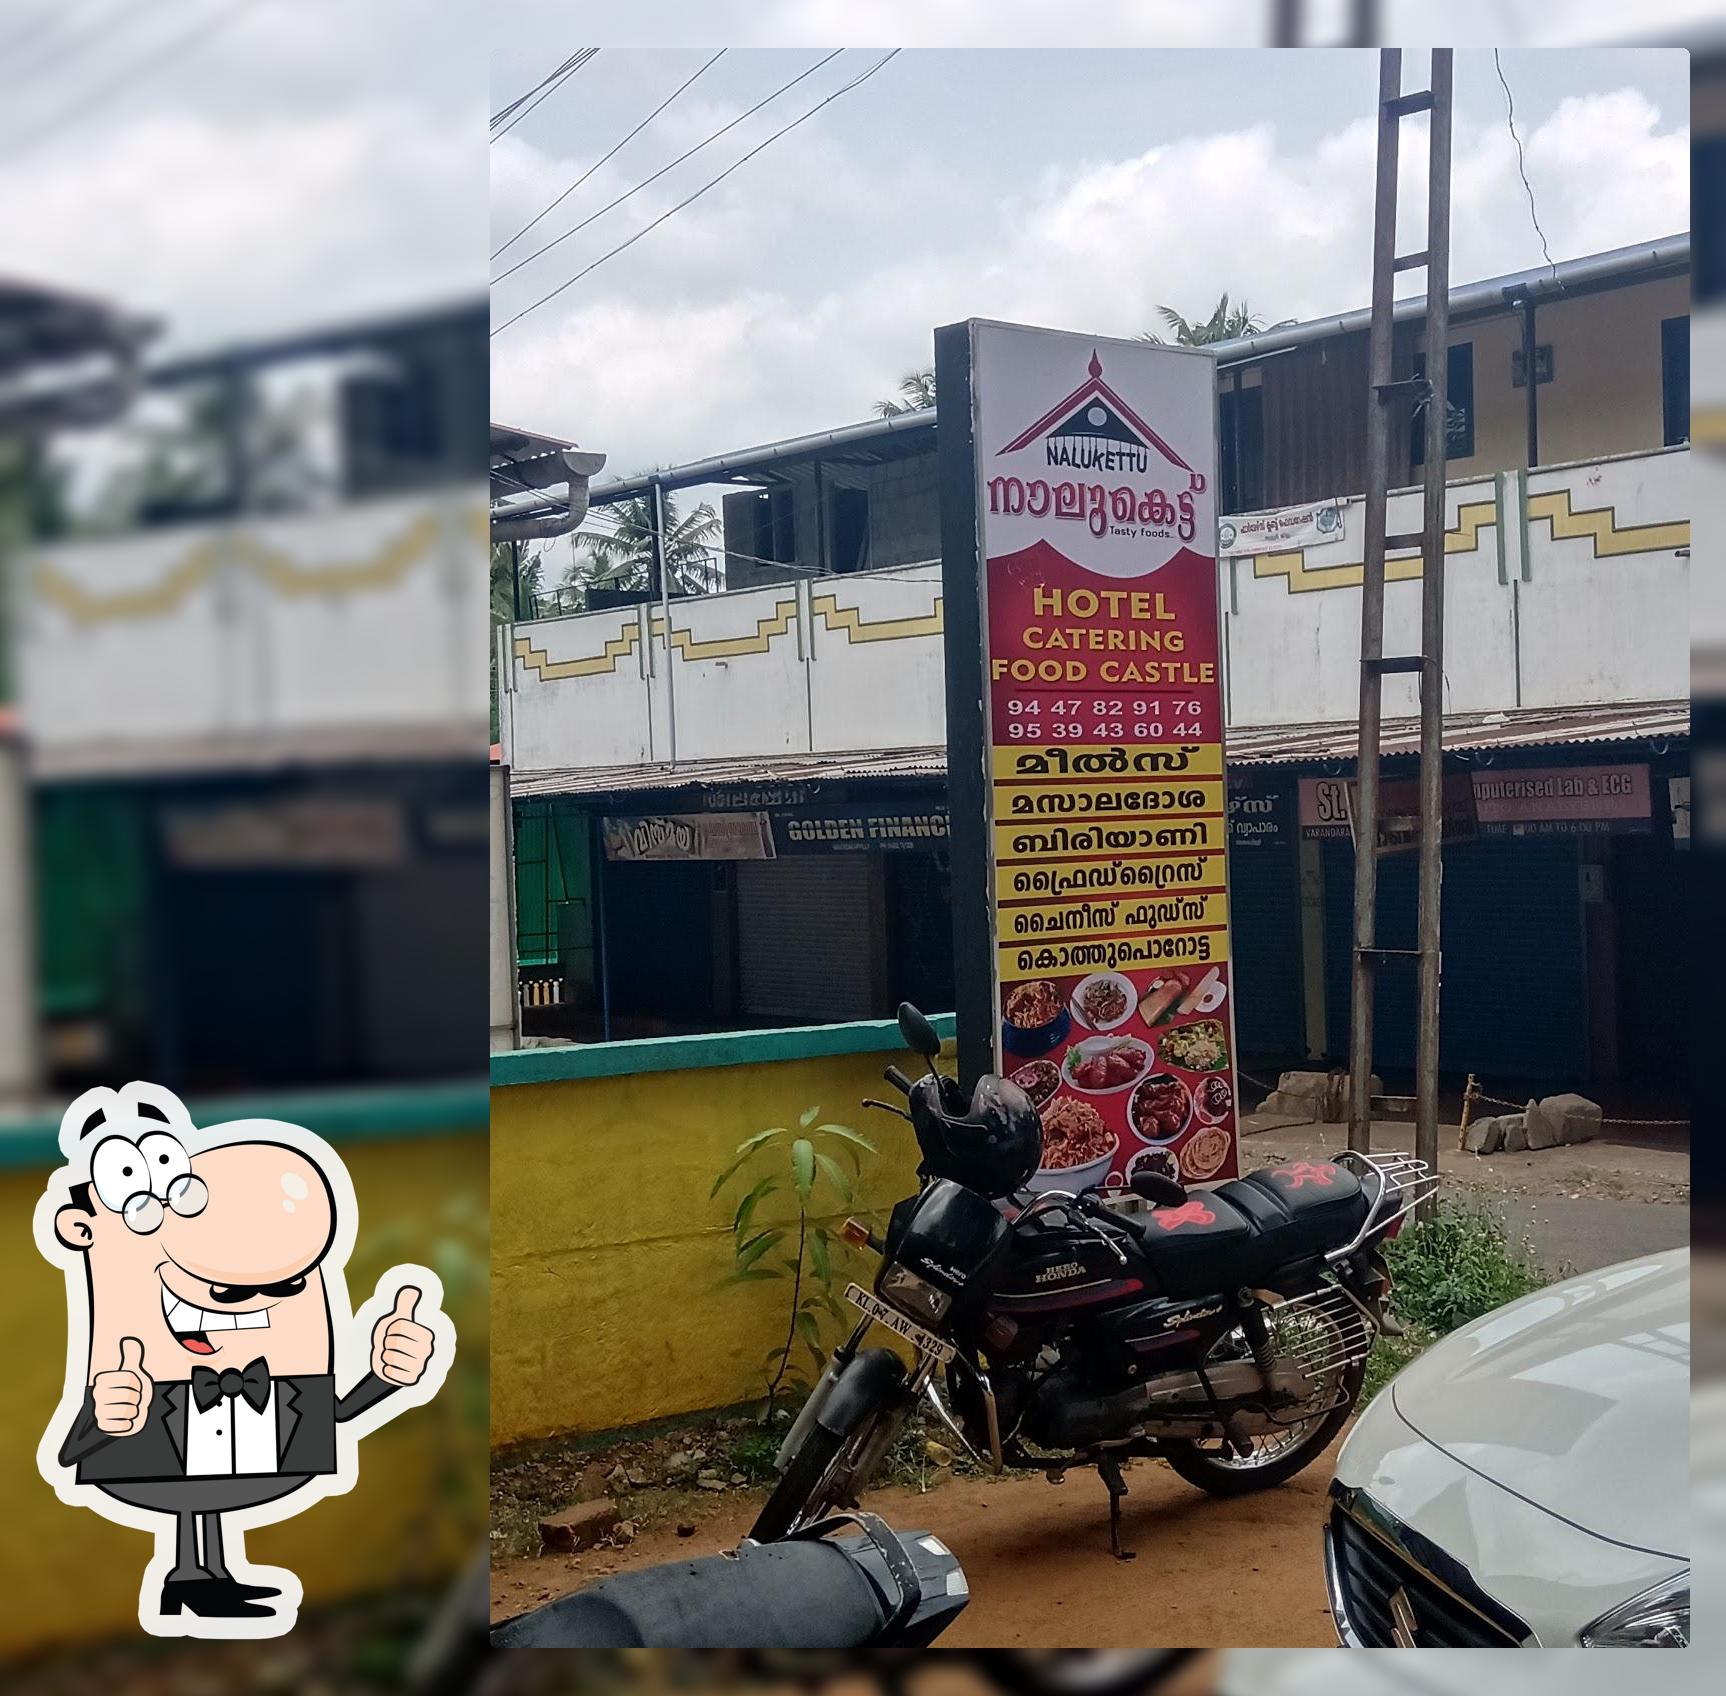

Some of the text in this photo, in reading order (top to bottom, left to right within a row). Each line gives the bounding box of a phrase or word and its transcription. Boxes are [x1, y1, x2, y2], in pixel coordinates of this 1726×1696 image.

[1047, 446, 1149, 473] NALUKETTU
[987, 473, 1207, 543] നാലുകെട്ട്
[1110, 525, 1137, 538] Tasty
[1033, 587, 1176, 620] HOTEL
[1022, 627, 1185, 652] CATERING
[992, 659, 1215, 683] FOOD CASTLE
[1007, 700, 1202, 716] 94 47 82 91 76
[1008, 722, 1203, 738] 95 39 43 60 44
[1016, 746, 1200, 774] മീൽസ്
[1557, 776, 1585, 797] Lab
[1587, 777, 1599, 795] &
[1602, 774, 1632, 795] ECG
[1011, 790, 1206, 814] മസാലദോശ
[788, 819, 864, 841] GOLDEN
[867, 814, 951, 840] FINANC
[1012, 823, 1207, 853] ബിരിയാണി
[1014, 896, 1208, 933] ചൈനീസ് ഫുഡ്സ്
[1035, 1266, 1087, 1283] HONDA
[1045, 1261, 1079, 1273] HERO
